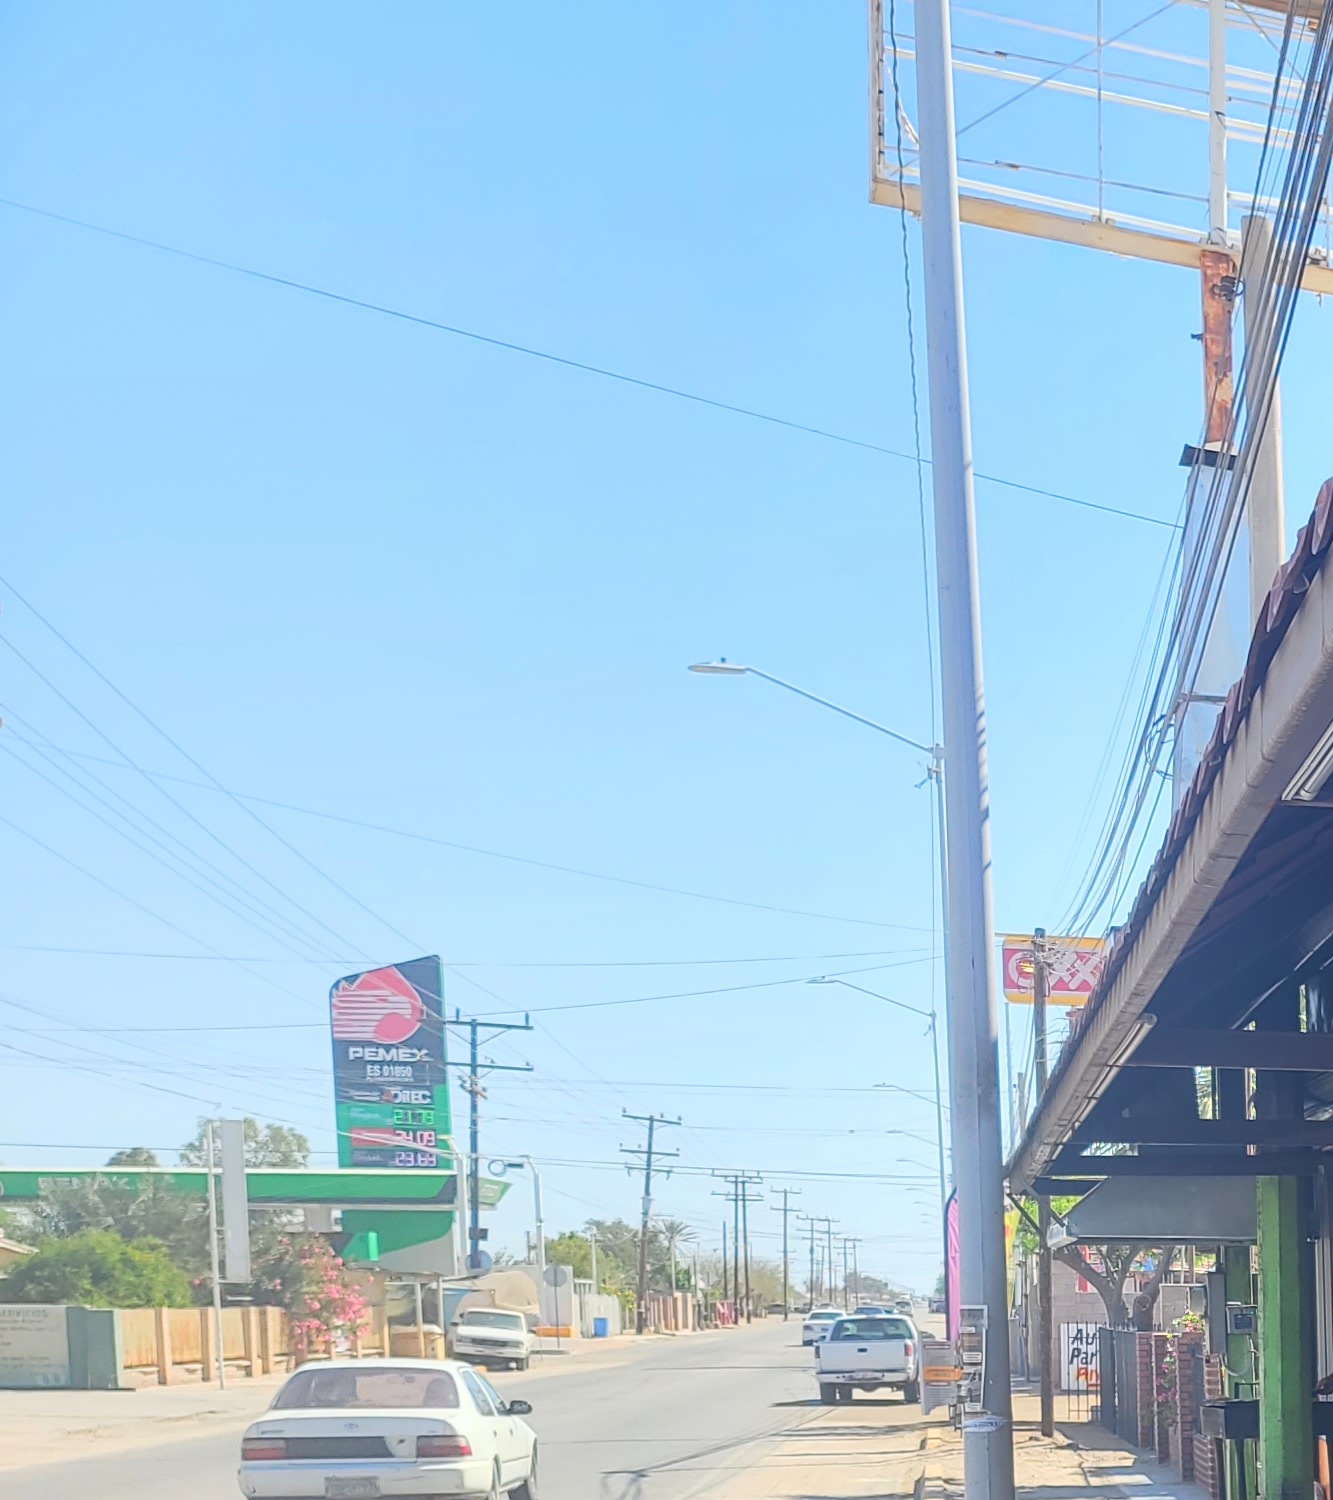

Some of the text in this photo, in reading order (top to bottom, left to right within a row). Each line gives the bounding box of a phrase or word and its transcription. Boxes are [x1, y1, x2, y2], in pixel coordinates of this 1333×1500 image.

[1008, 950, 1101, 990] OXX
[349, 1046, 431, 1061] PEMEX
[366, 1064, 380, 1076] ES
[1071, 1328, 1099, 1346] Au
[1069, 1347, 1099, 1365] Par
